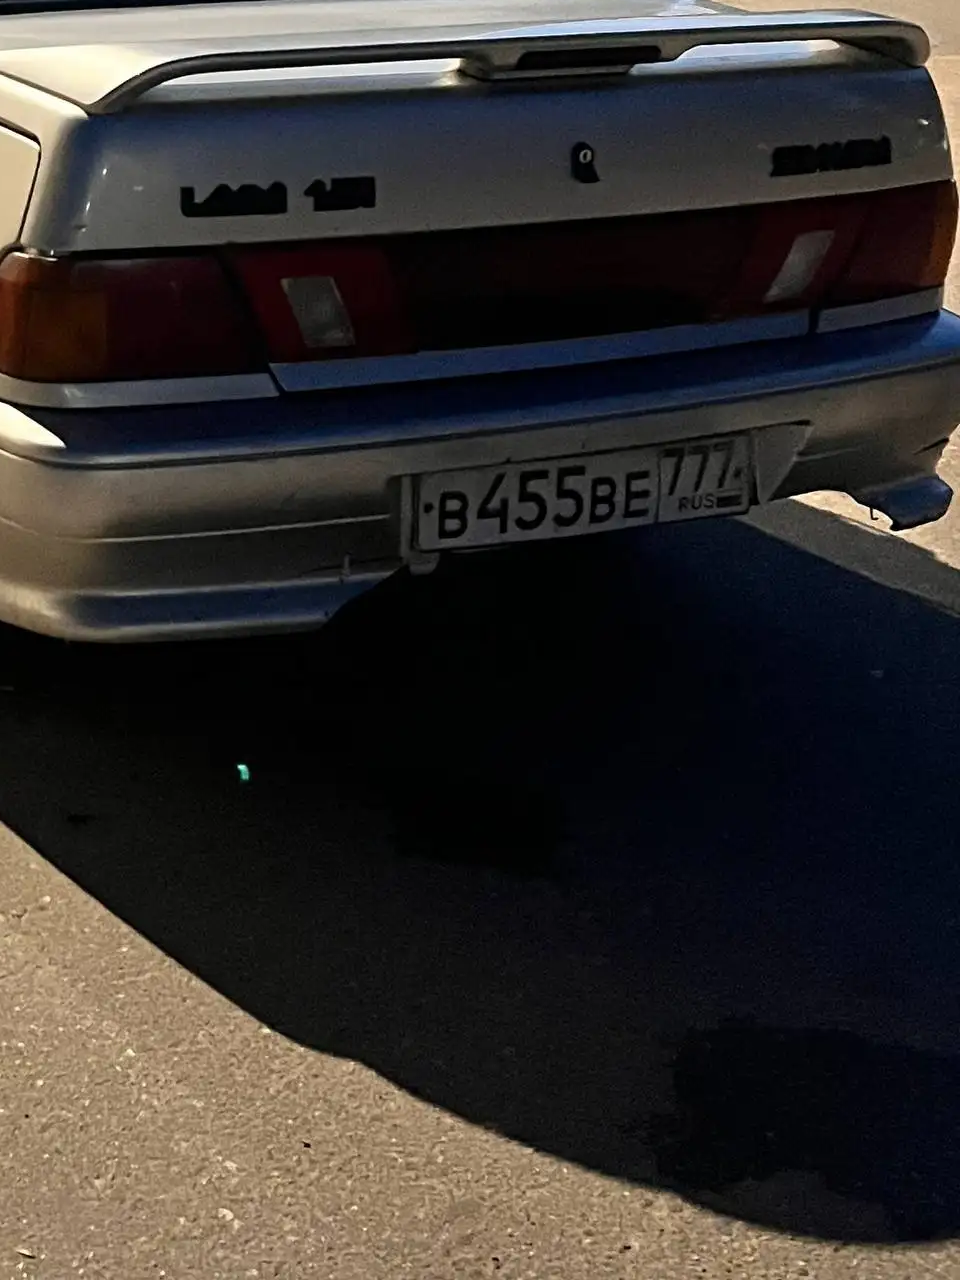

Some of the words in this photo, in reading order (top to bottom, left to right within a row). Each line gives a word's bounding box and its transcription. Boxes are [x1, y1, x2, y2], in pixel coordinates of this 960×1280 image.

[438, 465, 650, 540] В455ВЕ
[660, 440, 736, 496] 777
[678, 495, 716, 513] RUS
